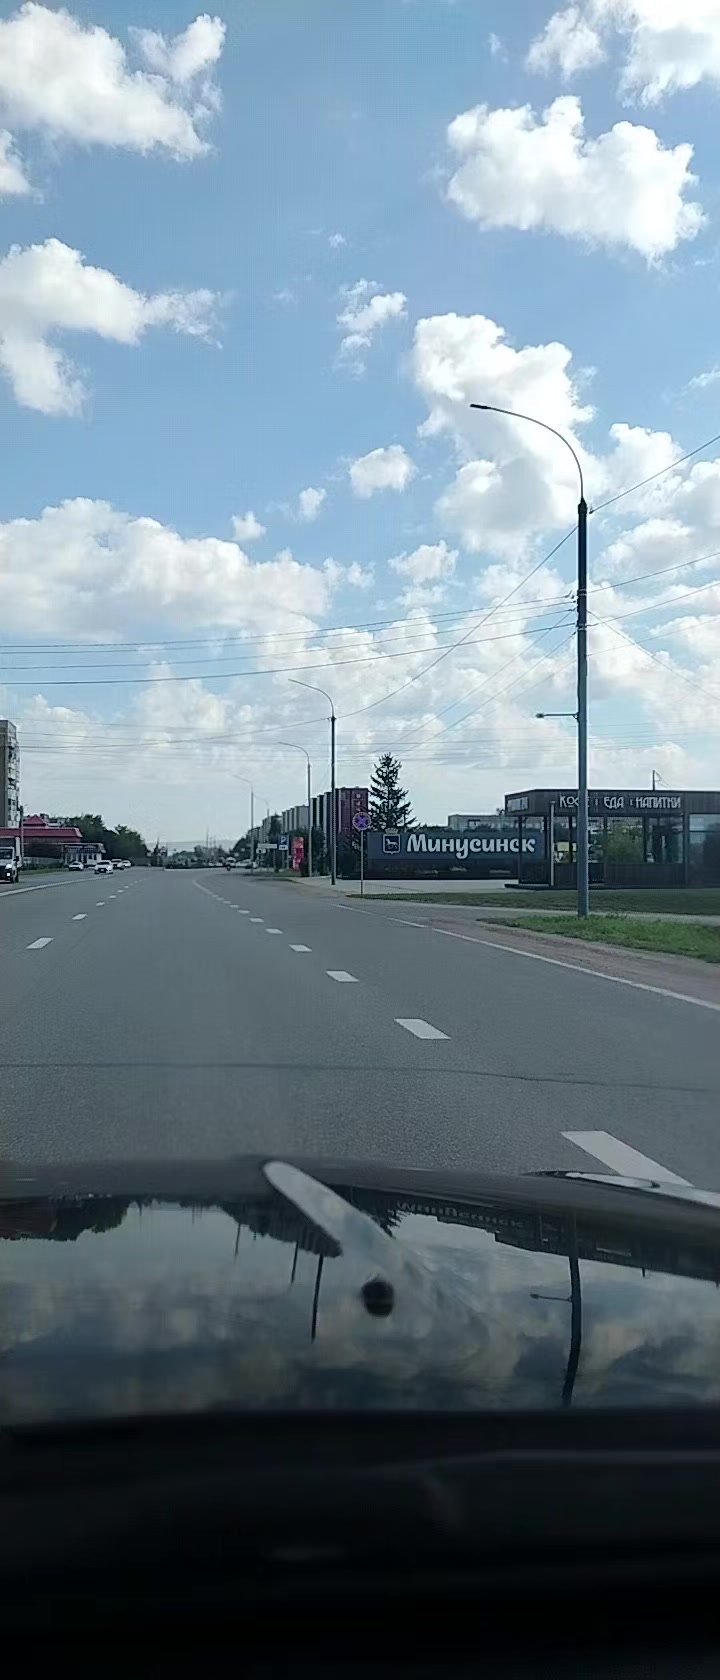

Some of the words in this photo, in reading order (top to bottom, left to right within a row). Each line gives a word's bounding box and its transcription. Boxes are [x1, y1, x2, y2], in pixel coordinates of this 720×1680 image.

[603, 796, 624, 809] ЕДА
[635, 796, 681, 809] НАПИТКИ
[406, 833, 536, 859] Минусинск
